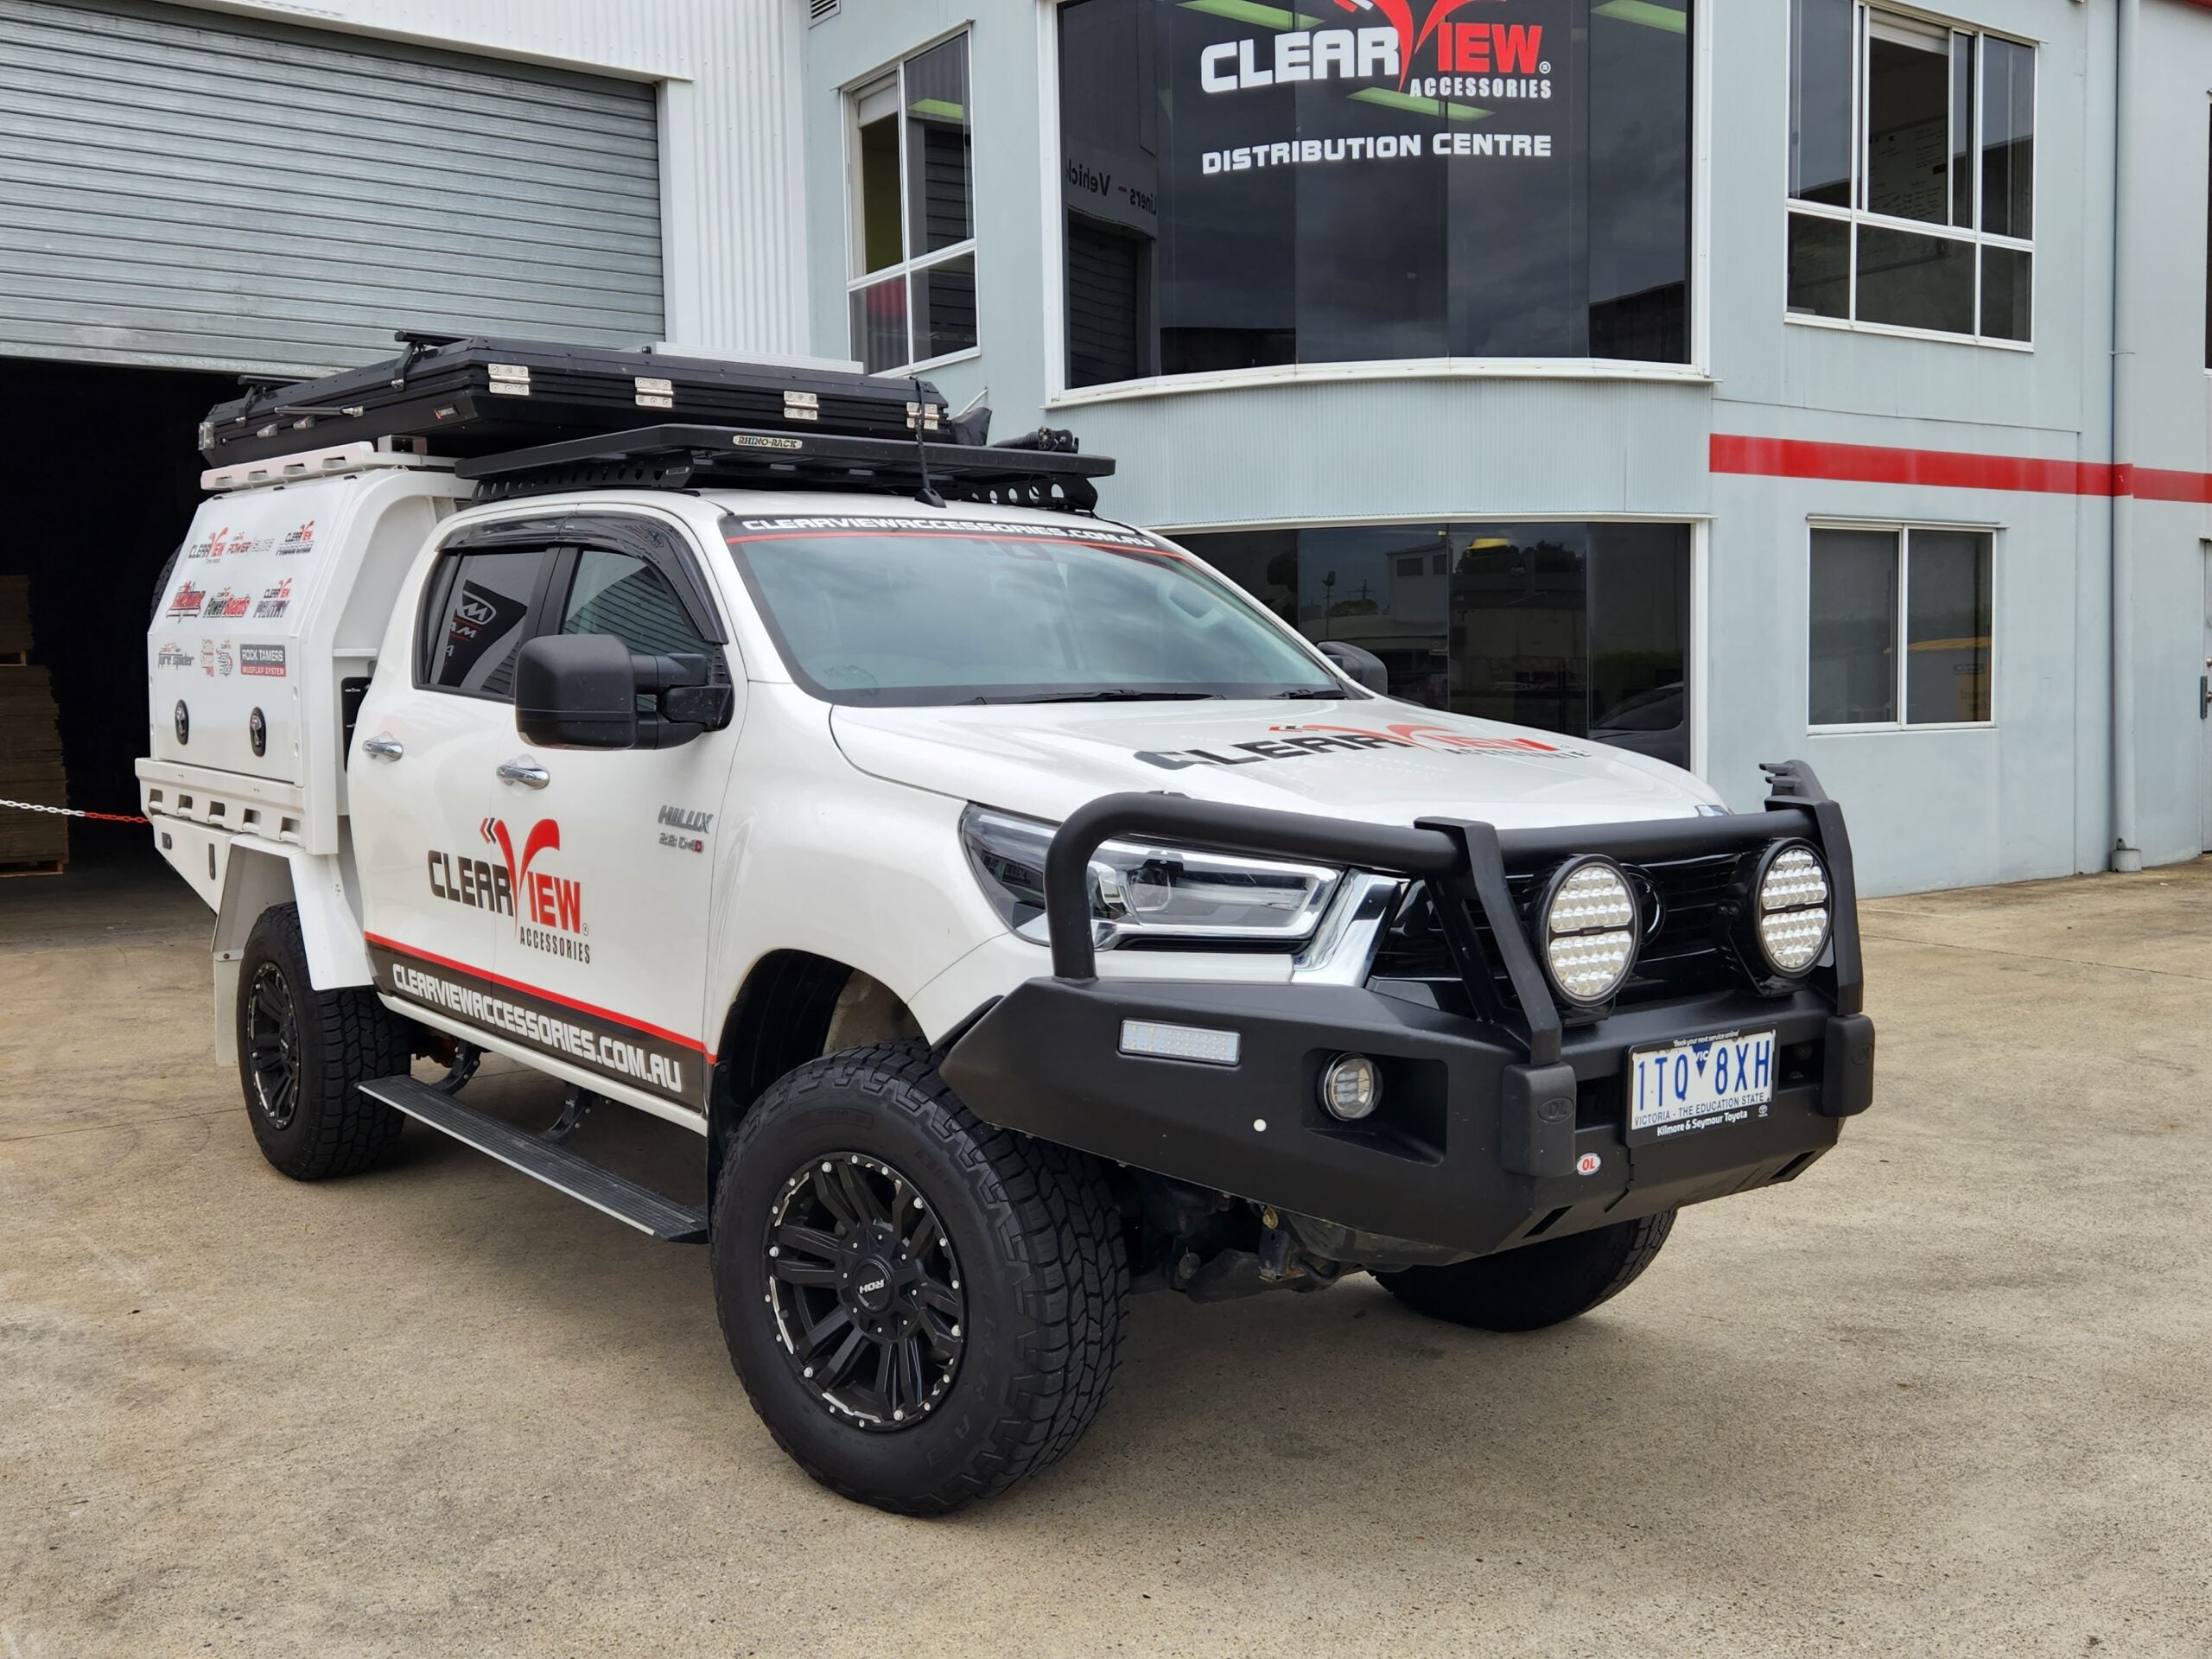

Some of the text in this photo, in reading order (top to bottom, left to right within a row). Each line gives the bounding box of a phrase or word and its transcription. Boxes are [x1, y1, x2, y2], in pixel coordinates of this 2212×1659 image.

[1409, 77, 1552, 99] ACCESSORIES
[1203, 133, 1552, 174] DISTRIBUTION CENTRE
[738, 436, 798, 448] RHINO-RACK
[742, 518, 1156, 548] CLEARVIEWACCESSORIES.COM.AU
[242, 649, 283, 662] ROCK TAMERS
[264, 666, 284, 677] SYSTEM
[658, 804, 715, 834] HILUX
[428, 818, 582, 938] CLEARVIEW
[520, 926, 591, 964] ACCESSORIES
[392, 963, 683, 1093] CLEARVIEWACCESSORIES.COM.AU
[1695, 1050, 1709, 1062] VIC
[1634, 1109, 1671, 1127] VICTORIA
[1679, 1105, 1694, 1116] THE
[1696, 1097, 1739, 1113] EDUCATION
[1741, 1092, 1764, 1105] STATE
[1656, 1109, 1748, 1137] Kilmore & Seymour Toyota
